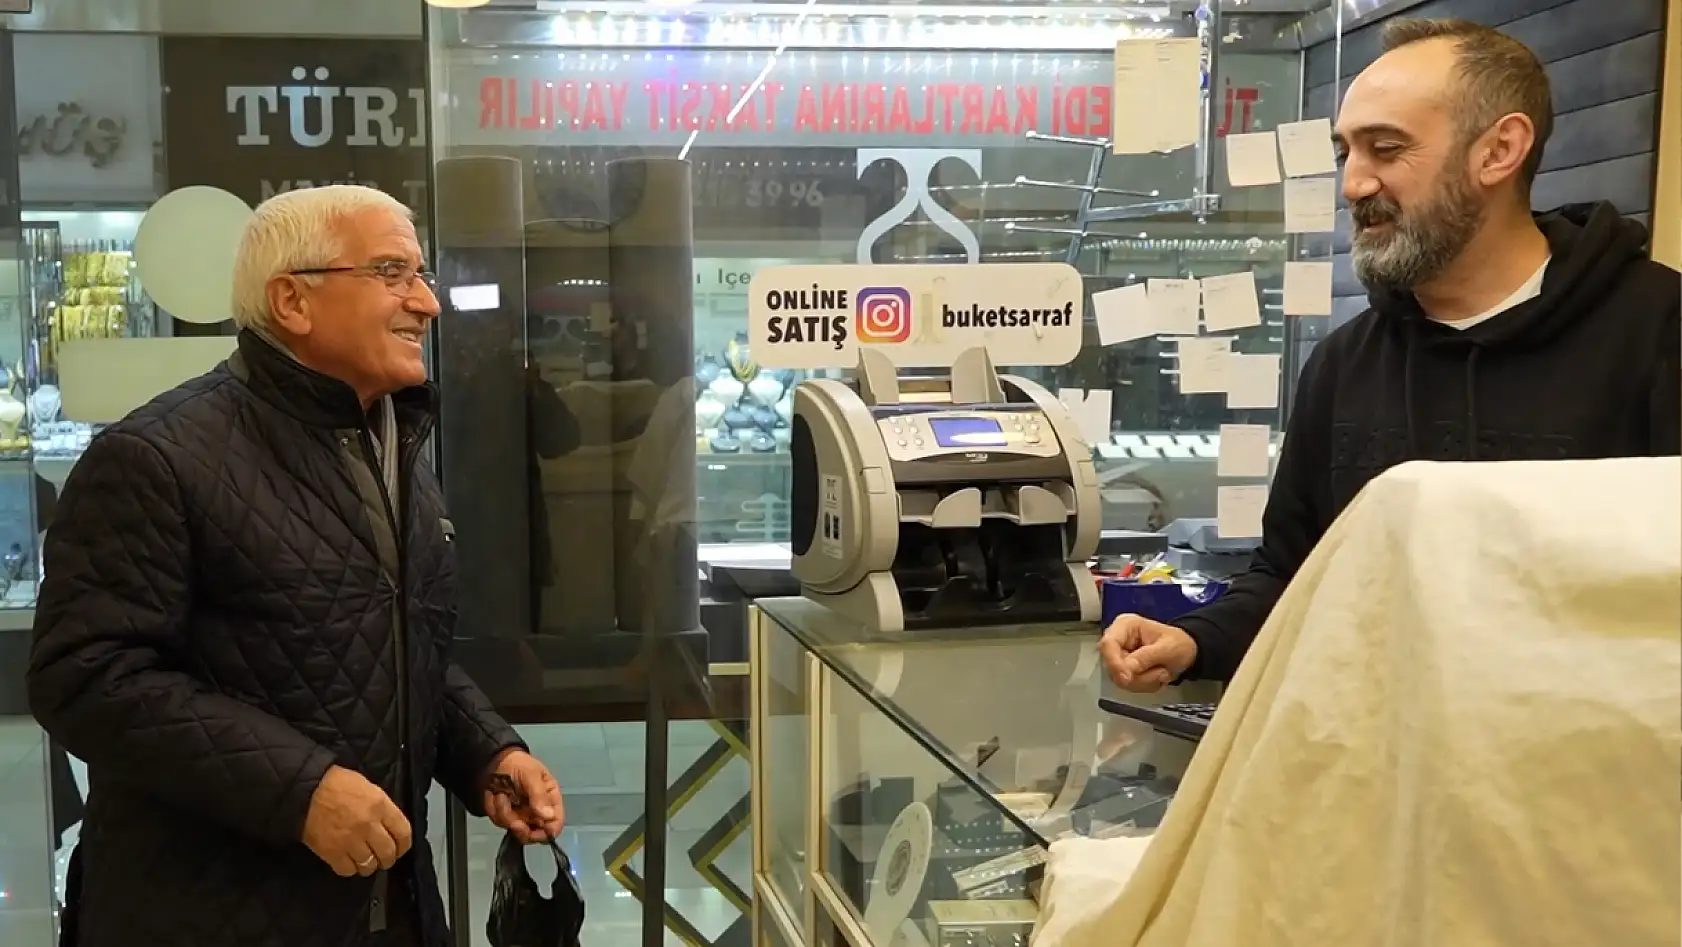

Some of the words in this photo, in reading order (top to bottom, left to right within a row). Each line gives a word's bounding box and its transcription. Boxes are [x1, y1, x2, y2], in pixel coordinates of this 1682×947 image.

[789, 177, 824, 207] 96
[767, 283, 848, 310] ONLİNE
[942, 301, 1073, 328] buketsarraf
[767, 316, 847, 350] SATIŞ
